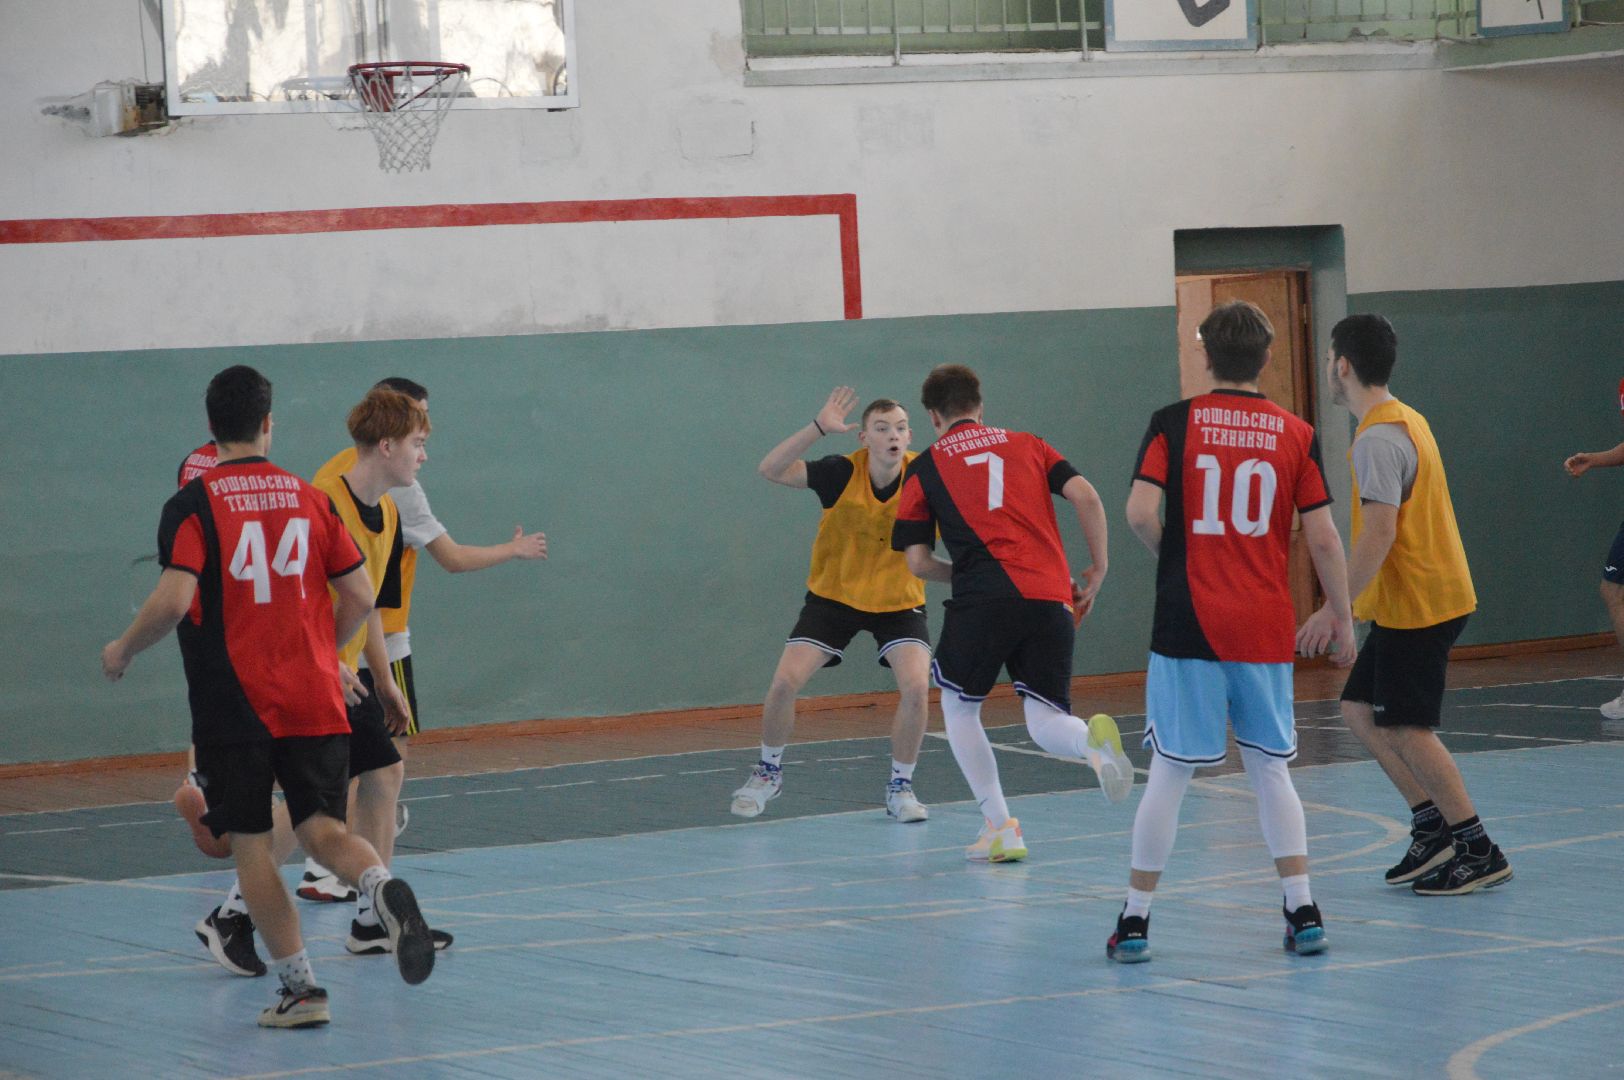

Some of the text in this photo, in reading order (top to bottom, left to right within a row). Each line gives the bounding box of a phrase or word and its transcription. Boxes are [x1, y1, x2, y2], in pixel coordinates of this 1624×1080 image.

[943, 433, 1009, 457] ТЕХНИКУМ
[1201, 427, 1277, 451] ТЕХНИКУМ
[224, 492, 300, 512] ТЕХНИКУМ
[963, 451, 1004, 511] 7
[1192, 453, 1277, 537] 10
[228, 517, 310, 604] 44
